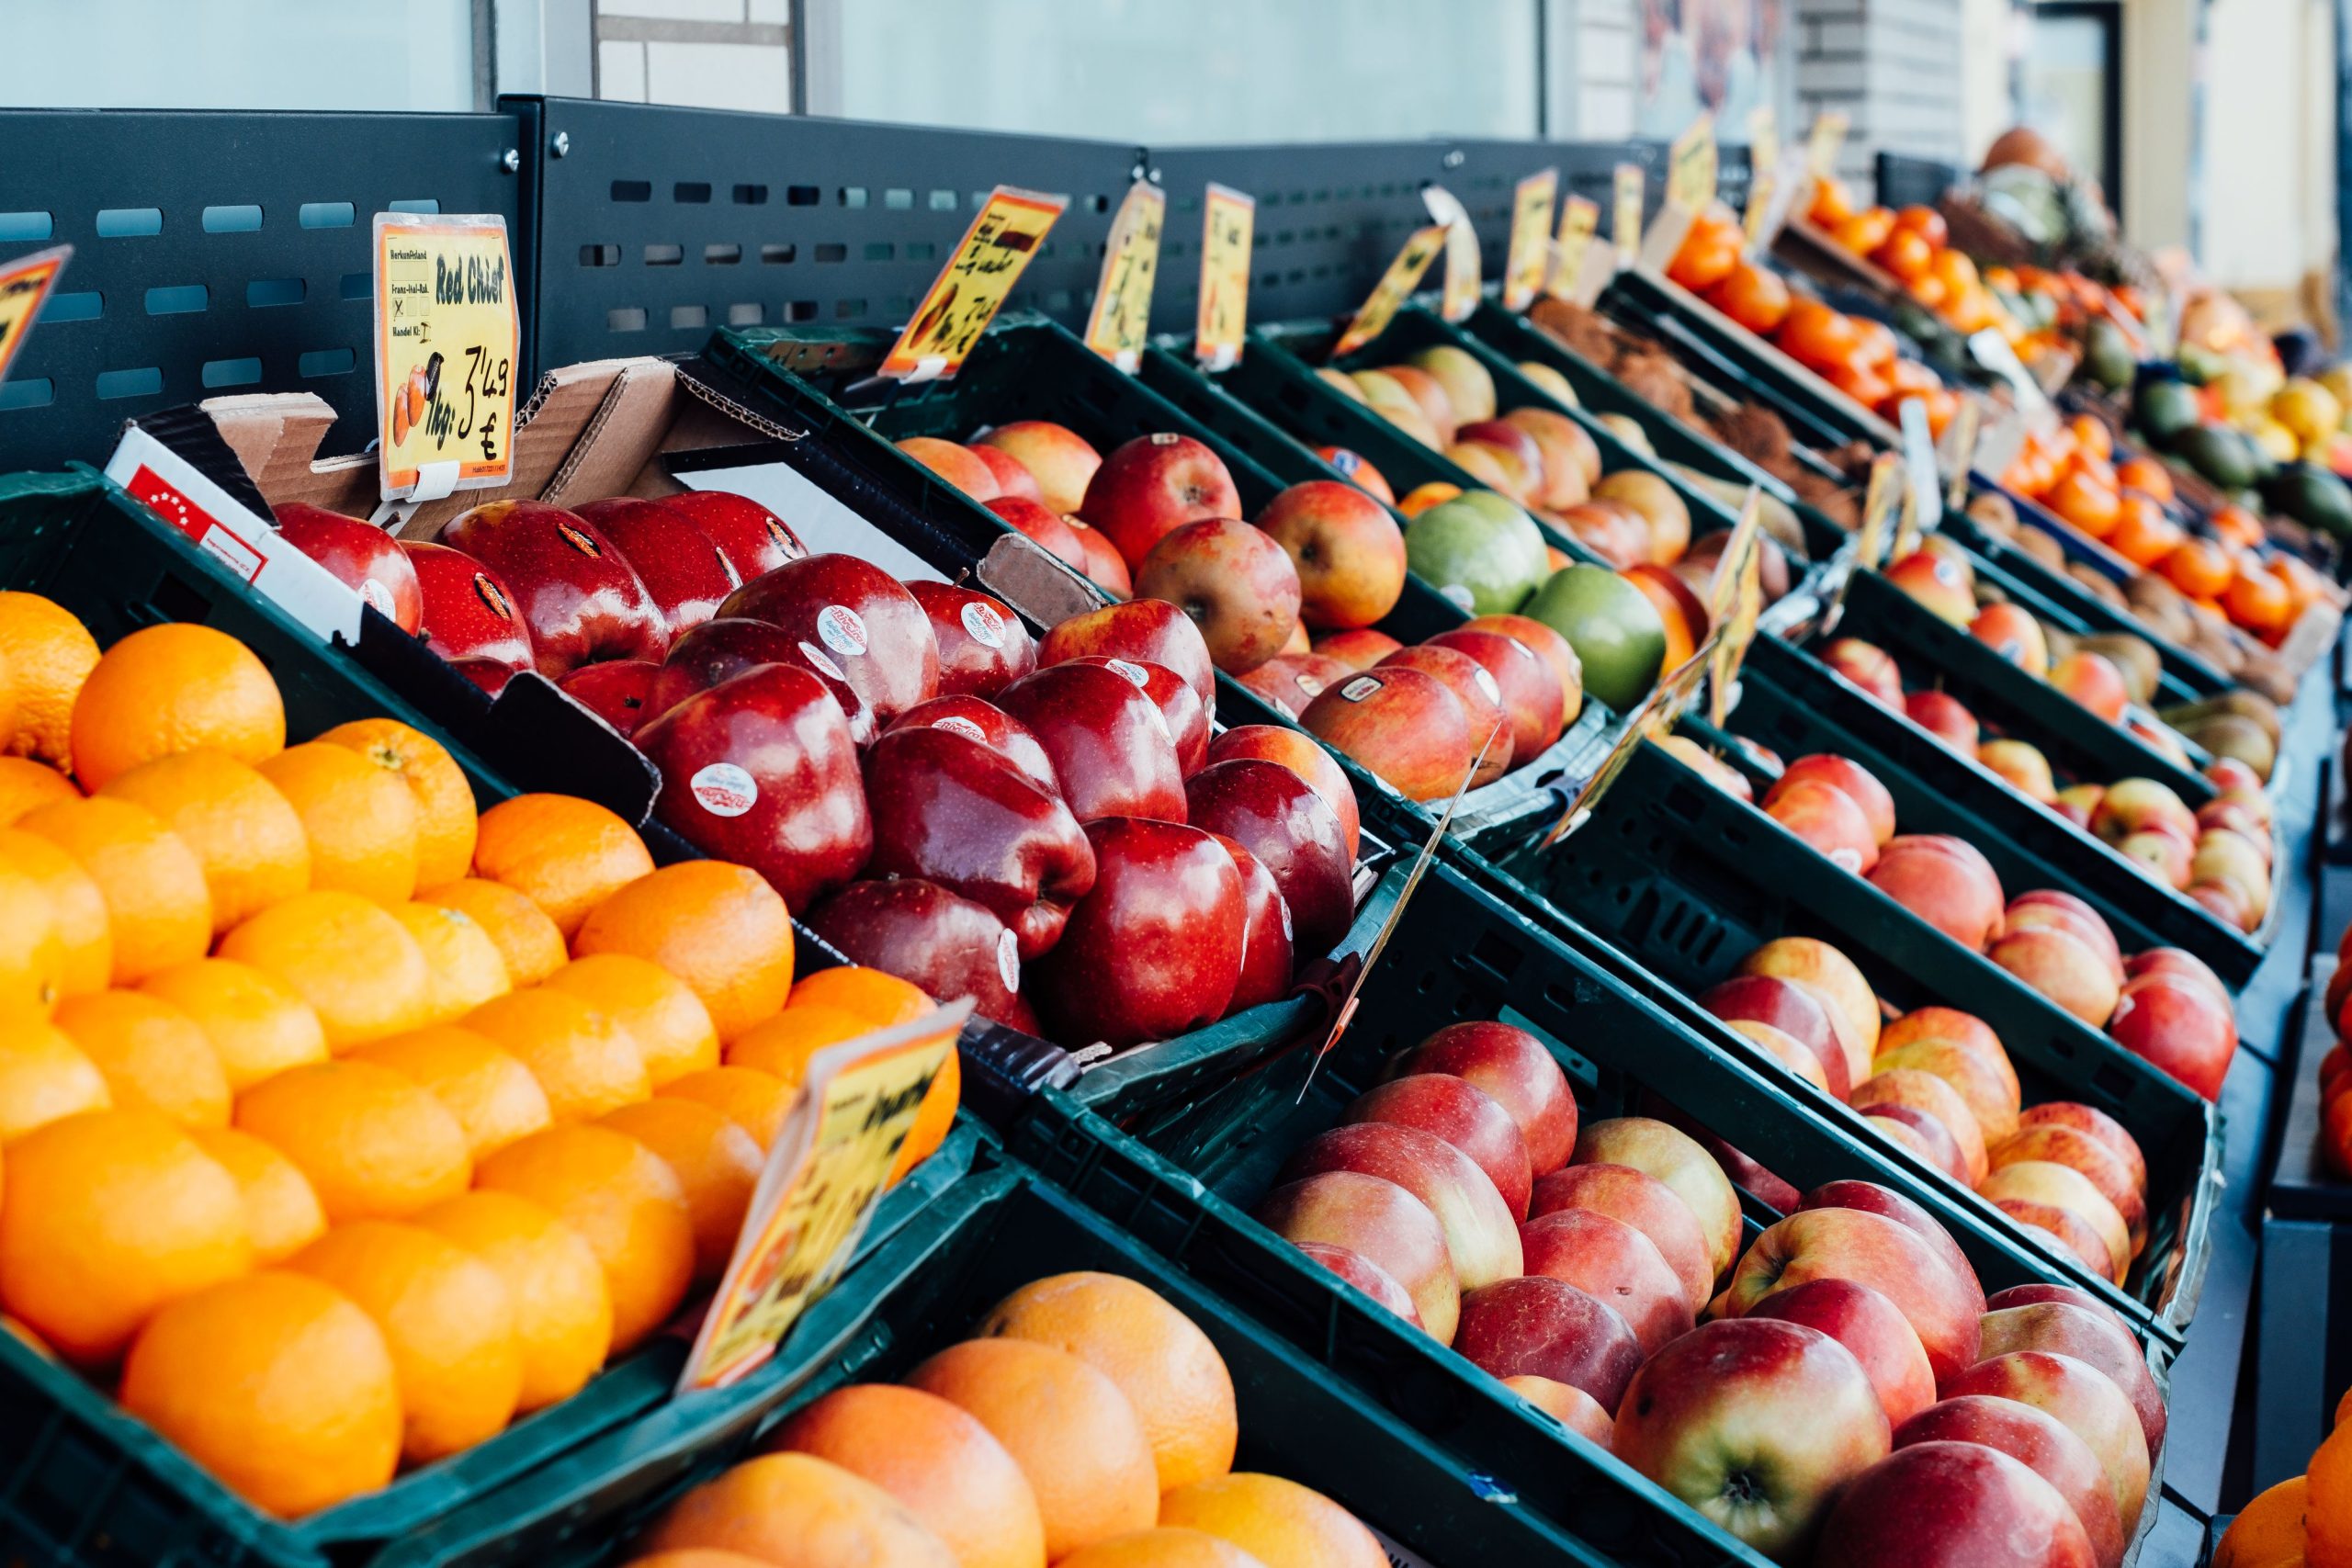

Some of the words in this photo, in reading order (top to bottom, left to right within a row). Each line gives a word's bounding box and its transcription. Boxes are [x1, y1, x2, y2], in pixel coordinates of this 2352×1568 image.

[435, 253, 464, 305] Red
[468, 253, 504, 305] Chief
[392, 326, 413, 337] Handel
[479, 412, 497, 461] €
